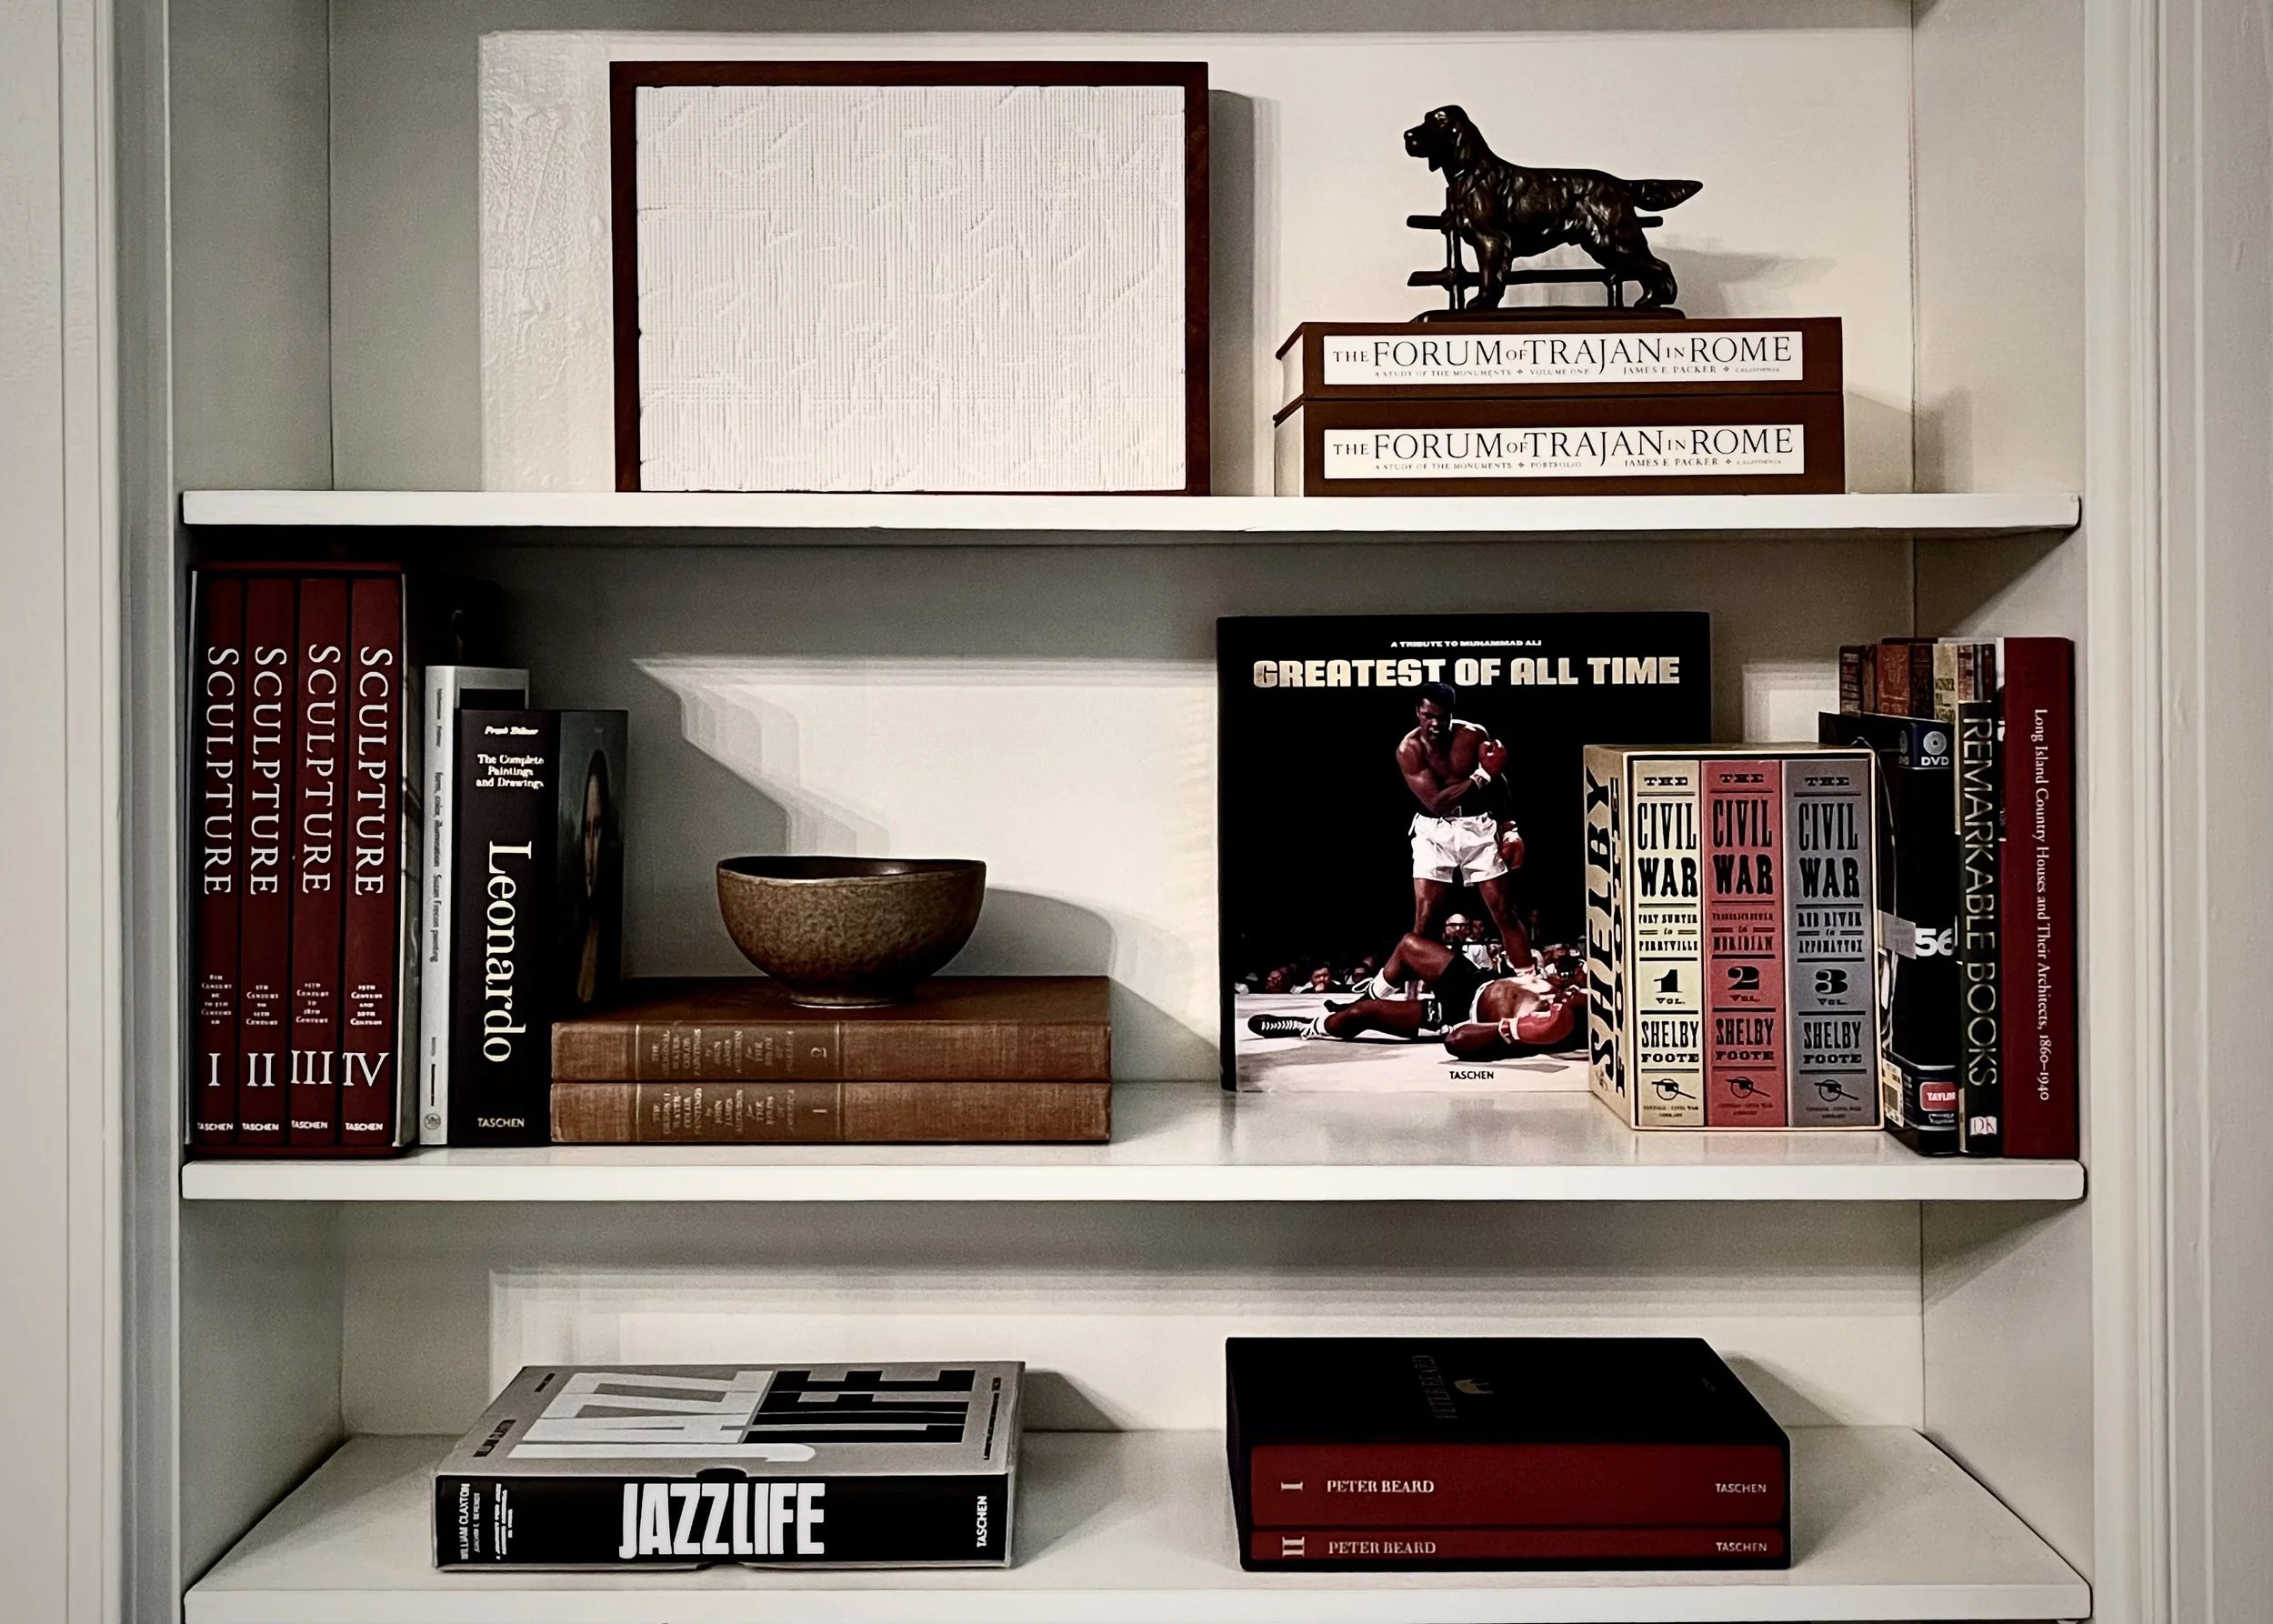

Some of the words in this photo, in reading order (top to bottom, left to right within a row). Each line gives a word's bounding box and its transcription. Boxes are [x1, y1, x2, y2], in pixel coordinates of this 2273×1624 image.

[1333, 350, 1369, 363] THE
[1374, 340, 1502, 367] FORUM
[1506, 349, 1527, 361] OF
[1523, 339, 1662, 375] TRAJAN
[1667, 346, 1685, 359] IN
[1690, 336, 1792, 363] ROME
[1453, 369, 1512, 377] MONUMENTS
[1624, 366, 1658, 375] JAMES
[1673, 365, 1717, 374] PACKER
[1333, 444, 1370, 456] THE
[1374, 433, 1503, 459] FORUM
[1507, 442, 1528, 454] OF
[1524, 431, 1663, 466] TRAJAN
[1667, 439, 1686, 451] IN
[1690, 428, 1793, 455] ROME
[1453, 462, 1512, 470] MONUMENTS
[1530, 461, 1582, 469] PORTFOLIO
[1624, 458, 1658, 467] JAMES
[1674, 457, 1718, 466] PACKER
[1459, 639, 1524, 647] MUHAMMAD
[1253, 657, 1447, 688] GREATEST
[1454, 657, 1501, 687] OF
[1510, 657, 1578, 686] ALL
[1587, 656, 1680, 685] TIME
[2031, 708, 2048, 743] Long
[204, 647, 239, 896] SCULPTURE
[249, 646, 287, 895] SCULPTURE
[301, 643, 341, 894] SCULPTURE
[355, 646, 394, 897] SCULPTURE
[476, 754, 496, 764] The
[499, 755, 545, 767] Complete
[487, 766, 534, 777] Paintings
[1920, 757, 1949, 767] DVD
[2034, 746, 2048, 784] Island
[476, 777, 495, 787] and
[497, 777, 545, 790] Drawings
[1644, 777, 1688, 787] THE
[1718, 774, 1765, 784] THE
[1804, 777, 1850, 787] THE
[1637, 802, 1697, 851] CIVIL
[1712, 798, 1773, 848] CIVIL
[1798, 802, 1858, 851] CIVIL
[2032, 787, 2049, 842] Country
[1962, 717, 1996, 950] REMARKABLE
[1637, 857, 1698, 898] WAR
[1712, 854, 1774, 895] WAR
[1798, 857, 1860, 898] WAR
[2036, 846, 2050, 893] Houses
[433, 874, 444, 898] Suzan
[1638, 913, 1659, 925] FORT
[1661, 913, 1698, 925] SUMTER
[1797, 912, 1819, 927] RED
[1824, 912, 1862, 927] RIVER
[2036, 896, 2050, 920] and
[1585, 764, 1614, 1080] SHELBY
[1663, 927, 1674, 936] to
[1825, 928, 1836, 937] to
[430, 929, 442, 963] painting
[1608, 776, 1625, 1098] FOOTE
[1638, 940, 1698, 952] PERRYVILLE
[1713, 936, 1774, 951] MERIDIAN
[1798, 939, 1863, 954] APPOMATTOX
[1915, 927, 1955, 957] 56
[2037, 923, 2052, 959] Their
[483, 840, 533, 1063] Leonardo
[1653, 968, 1684, 994] 1
[1727, 965, 1760, 991] 2
[1815, 968, 1848, 994] 3
[1729, 994, 1760, 1003] VOL.
[1817, 997, 1847, 1006] VOL.
[2035, 962, 2051, 1030] Architects,
[1640, 1020, 1699, 1048] SHELBY
[1715, 1018, 1775, 1046] SHELBY
[1803, 1021, 1862, 1049] SHELBY
[1967, 962, 1998, 1087] BOOKS
[291, 1049, 335, 1085] III
[1640, 1053, 1700, 1064] FOOTE
[1715, 1050, 1775, 1061] FOOTE
[1803, 1053, 1862, 1064] FOOTE
[208, 1052, 222, 1087] I
[247, 1053, 275, 1087] II
[342, 1051, 390, 1087] IV
[1448, 1070, 1495, 1080] TASCHEN
[197, 1122, 234, 1131] TASCHEN
[242, 1122, 279, 1131] TASCHEN
[291, 1120, 328, 1129] TASCHEN
[345, 1122, 384, 1131] TASCHEN
[476, 1118, 526, 1128] TASCHEN
[1972, 1118, 1995, 1133] DK
[1281, 1480, 1304, 1492] I
[1327, 1479, 1377, 1494] PETER
[1381, 1479, 1435, 1494] BEARD
[1715, 1482, 1767, 1493] TASCHEN
[458, 1483, 470, 1525] CLAXTON
[976, 1495, 988, 1549] TASCHEN
[458, 1526, 469, 1560] WILLIAM
[1281, 1536, 1306, 1558] II
[1327, 1541, 1380, 1554] PETER
[1383, 1540, 1437, 1554] BEARD
[1716, 1541, 1768, 1552] TASCHEN
